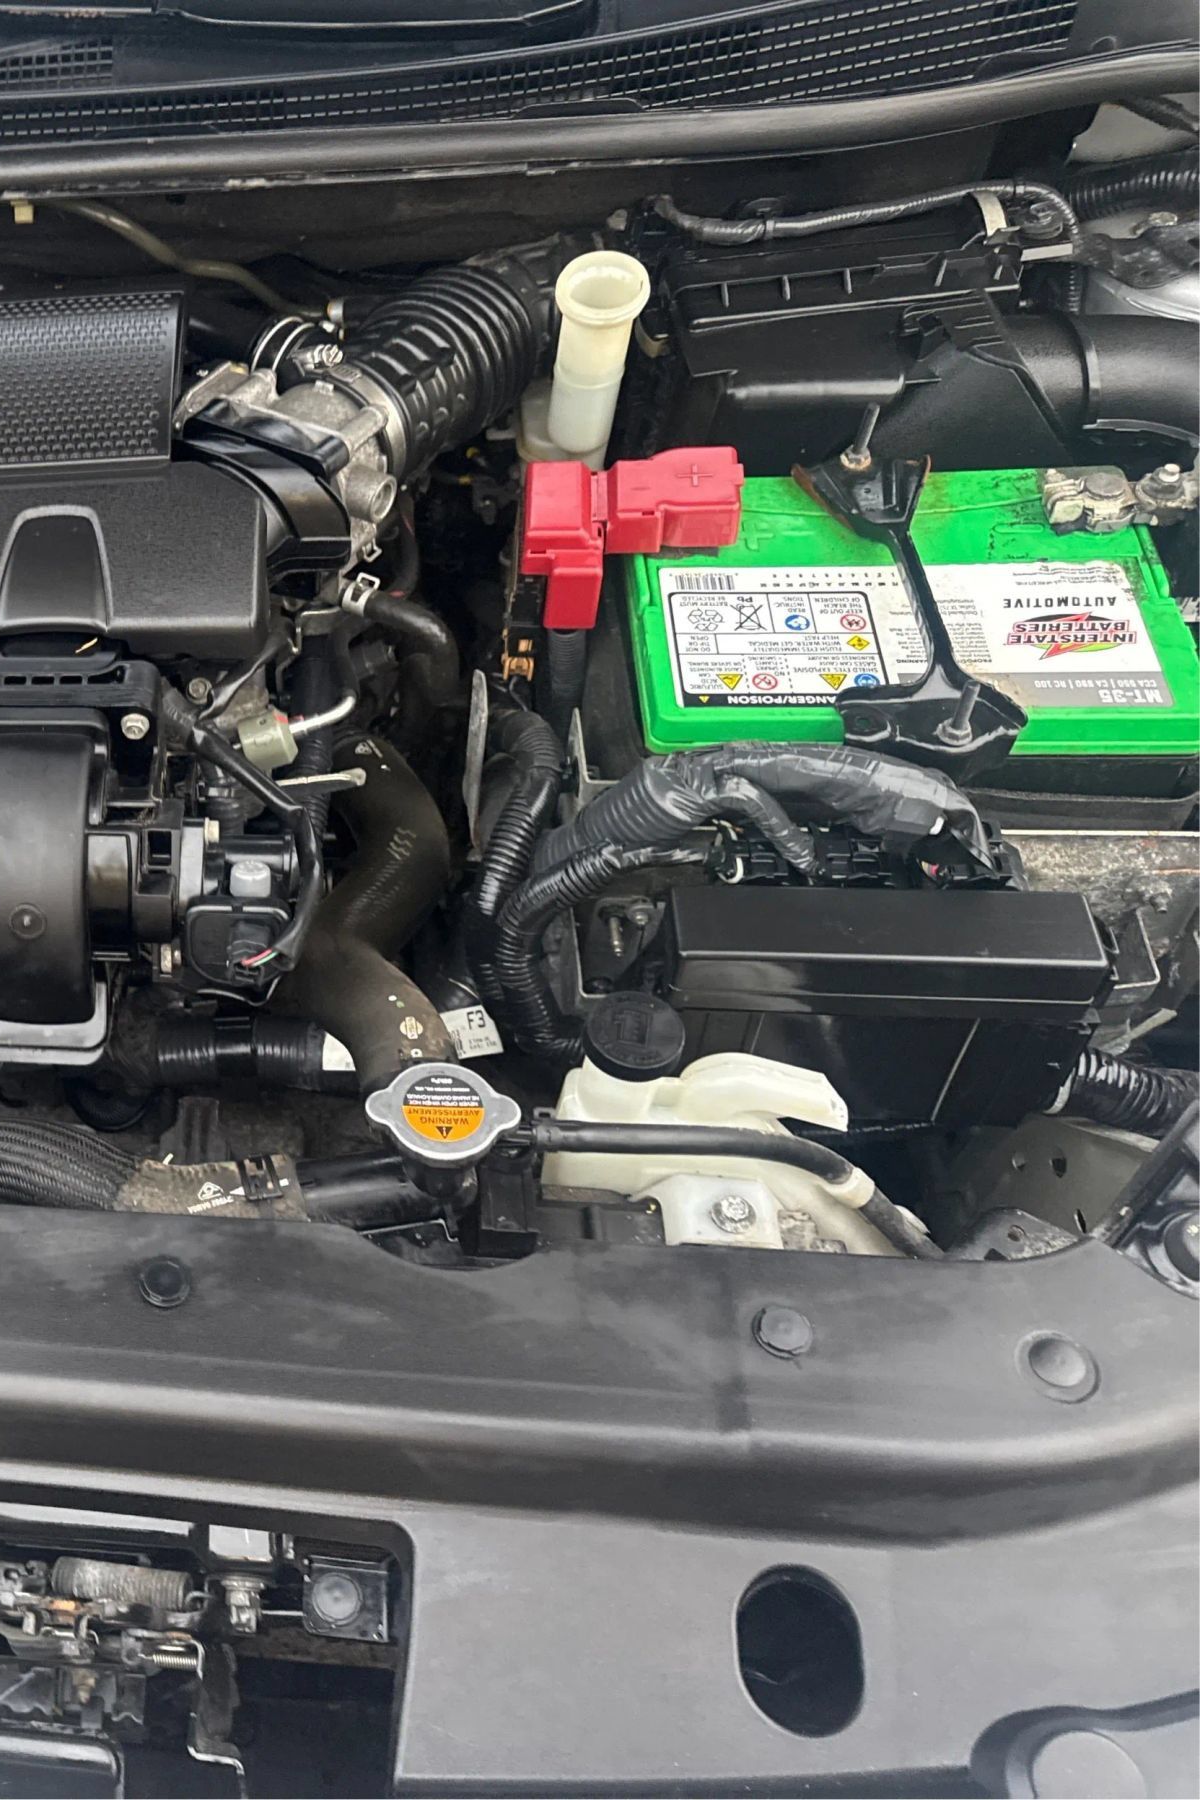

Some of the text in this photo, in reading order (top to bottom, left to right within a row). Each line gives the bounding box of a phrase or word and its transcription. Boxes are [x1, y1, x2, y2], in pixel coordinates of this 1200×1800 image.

[1002, 596, 1116, 608] AUTOMOTIVE
[1012, 621, 1129, 633] BATTERIES
[1007, 632, 1136, 645] INTERSTATE
[1034, 680, 1051, 688] 100
[1098, 689, 1163, 703] MT-35
[466, 1009, 486, 1030] F3
[407, 1108, 480, 1116] AVERTISSEMENT
[420, 1117, 468, 1125] WARNING
